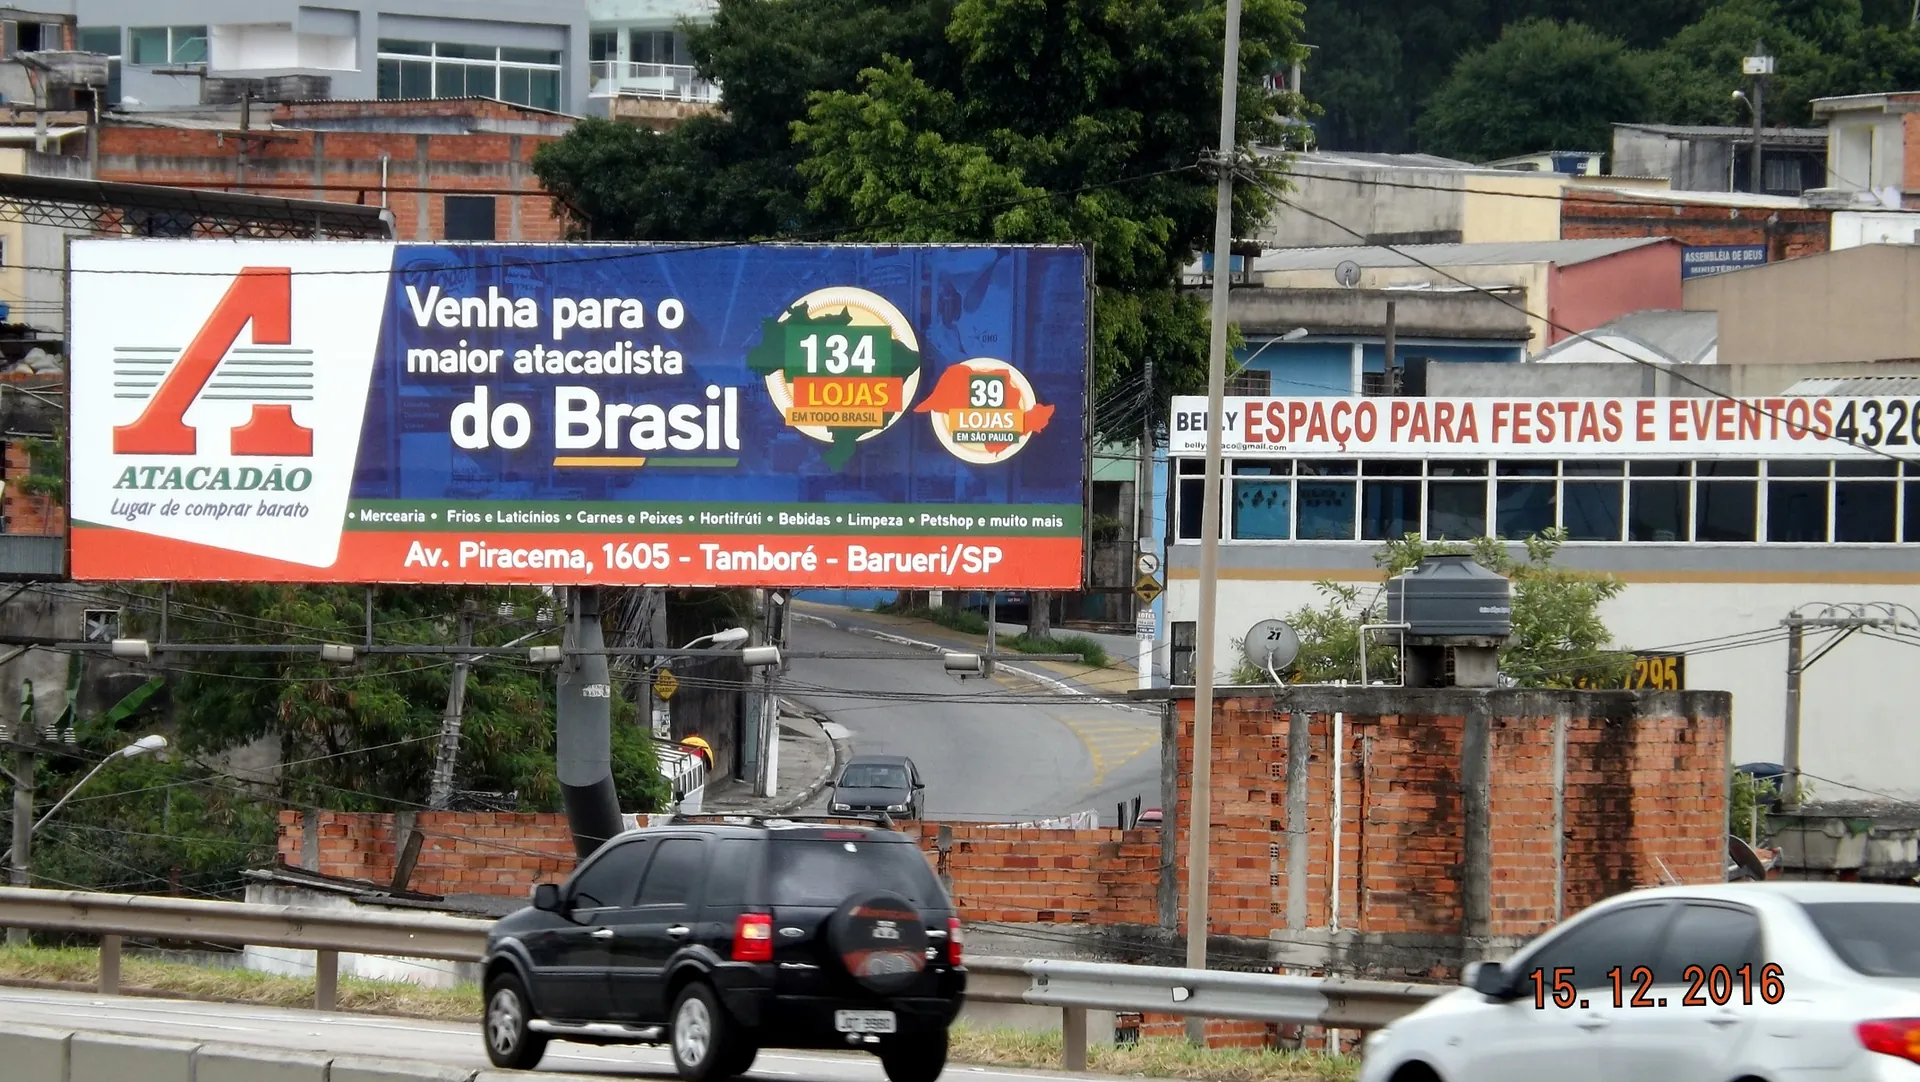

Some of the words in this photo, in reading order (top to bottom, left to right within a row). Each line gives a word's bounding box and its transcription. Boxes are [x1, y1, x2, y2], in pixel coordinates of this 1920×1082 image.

[1732, 251, 1742, 260] DE
[1743, 250, 1763, 260] DEUS
[406, 286, 537, 328] Venha
[553, 297, 644, 340] para
[657, 298, 684, 329] o
[407, 340, 504, 373] maior
[513, 341, 683, 374] atacadista
[800, 334, 876, 374] 134
[808, 382, 889, 406] LOJAS
[971, 380, 1004, 407] 39
[450, 385, 532, 450] do
[555, 384, 740, 450] Brasil
[792, 412, 807, 422] EM
[810, 412, 839, 422] TODO
[841, 412, 877, 422] BRASIL
[959, 412, 1014, 428] LOJAS
[1245, 400, 1378, 452] ESPAÇO
[1391, 401, 1479, 443] PARA
[1492, 400, 1623, 443] FESTAS
[1636, 400, 1655, 442] E
[1669, 398, 1833, 442] EVENTOS
[957, 433, 968, 441] EM
[971, 432, 986, 441] SÃO
[988, 433, 1014, 441] PAULO
[112, 464, 312, 492] ATACADÃO
[110, 498, 156, 521] Lugar
[160, 498, 180, 516] de
[185, 502, 252, 520] comprar
[256, 499, 309, 518] barato
[360, 509, 425, 523] Mercearia
[447, 510, 481, 523] Frios
[485, 513, 493, 523] e
[497, 510, 560, 524] Laticínios
[577, 511, 623, 524] Carnes
[627, 514, 636, 524] e
[640, 511, 683, 525] Peixes
[700, 512, 762, 525] Hortifrúti
[779, 513, 831, 526] Bebidas
[848, 513, 903, 529] Limpeza
[921, 513, 973, 530] Petshop
[978, 517, 985, 527] e
[990, 514, 1028, 527] muito
[1032, 514, 1063, 528] mais
[404, 540, 449, 568] Av.
[459, 540, 594, 574] Piracema,
[602, 542, 670, 570] 1605
[700, 544, 817, 571] Tamboré
[848, 543, 1003, 576] Barueri/SP
[1267, 631, 1281, 640] 21
